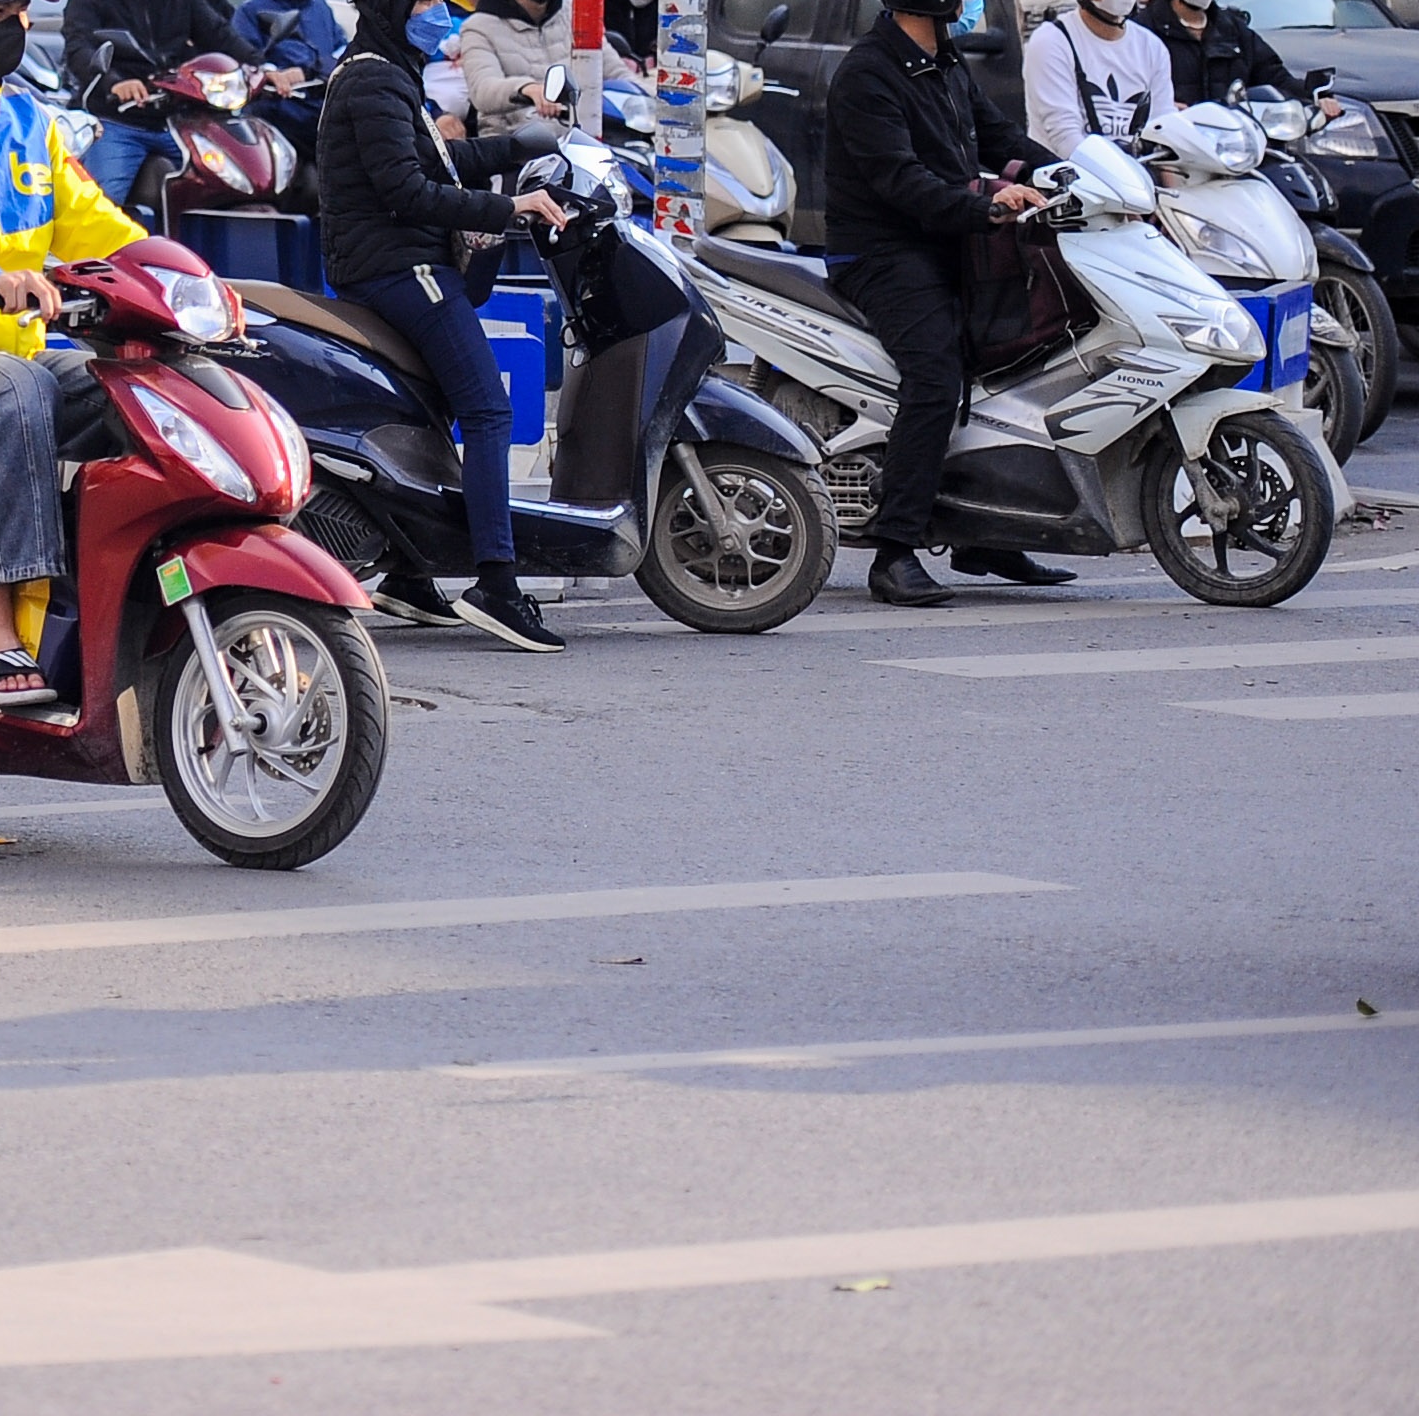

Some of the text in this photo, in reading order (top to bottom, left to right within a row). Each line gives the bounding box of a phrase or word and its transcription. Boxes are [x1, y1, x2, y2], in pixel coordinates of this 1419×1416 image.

[9, 151, 53, 196] be
[733, 294, 767, 309] AIR
[1117, 374, 1166, 388] HONDA
